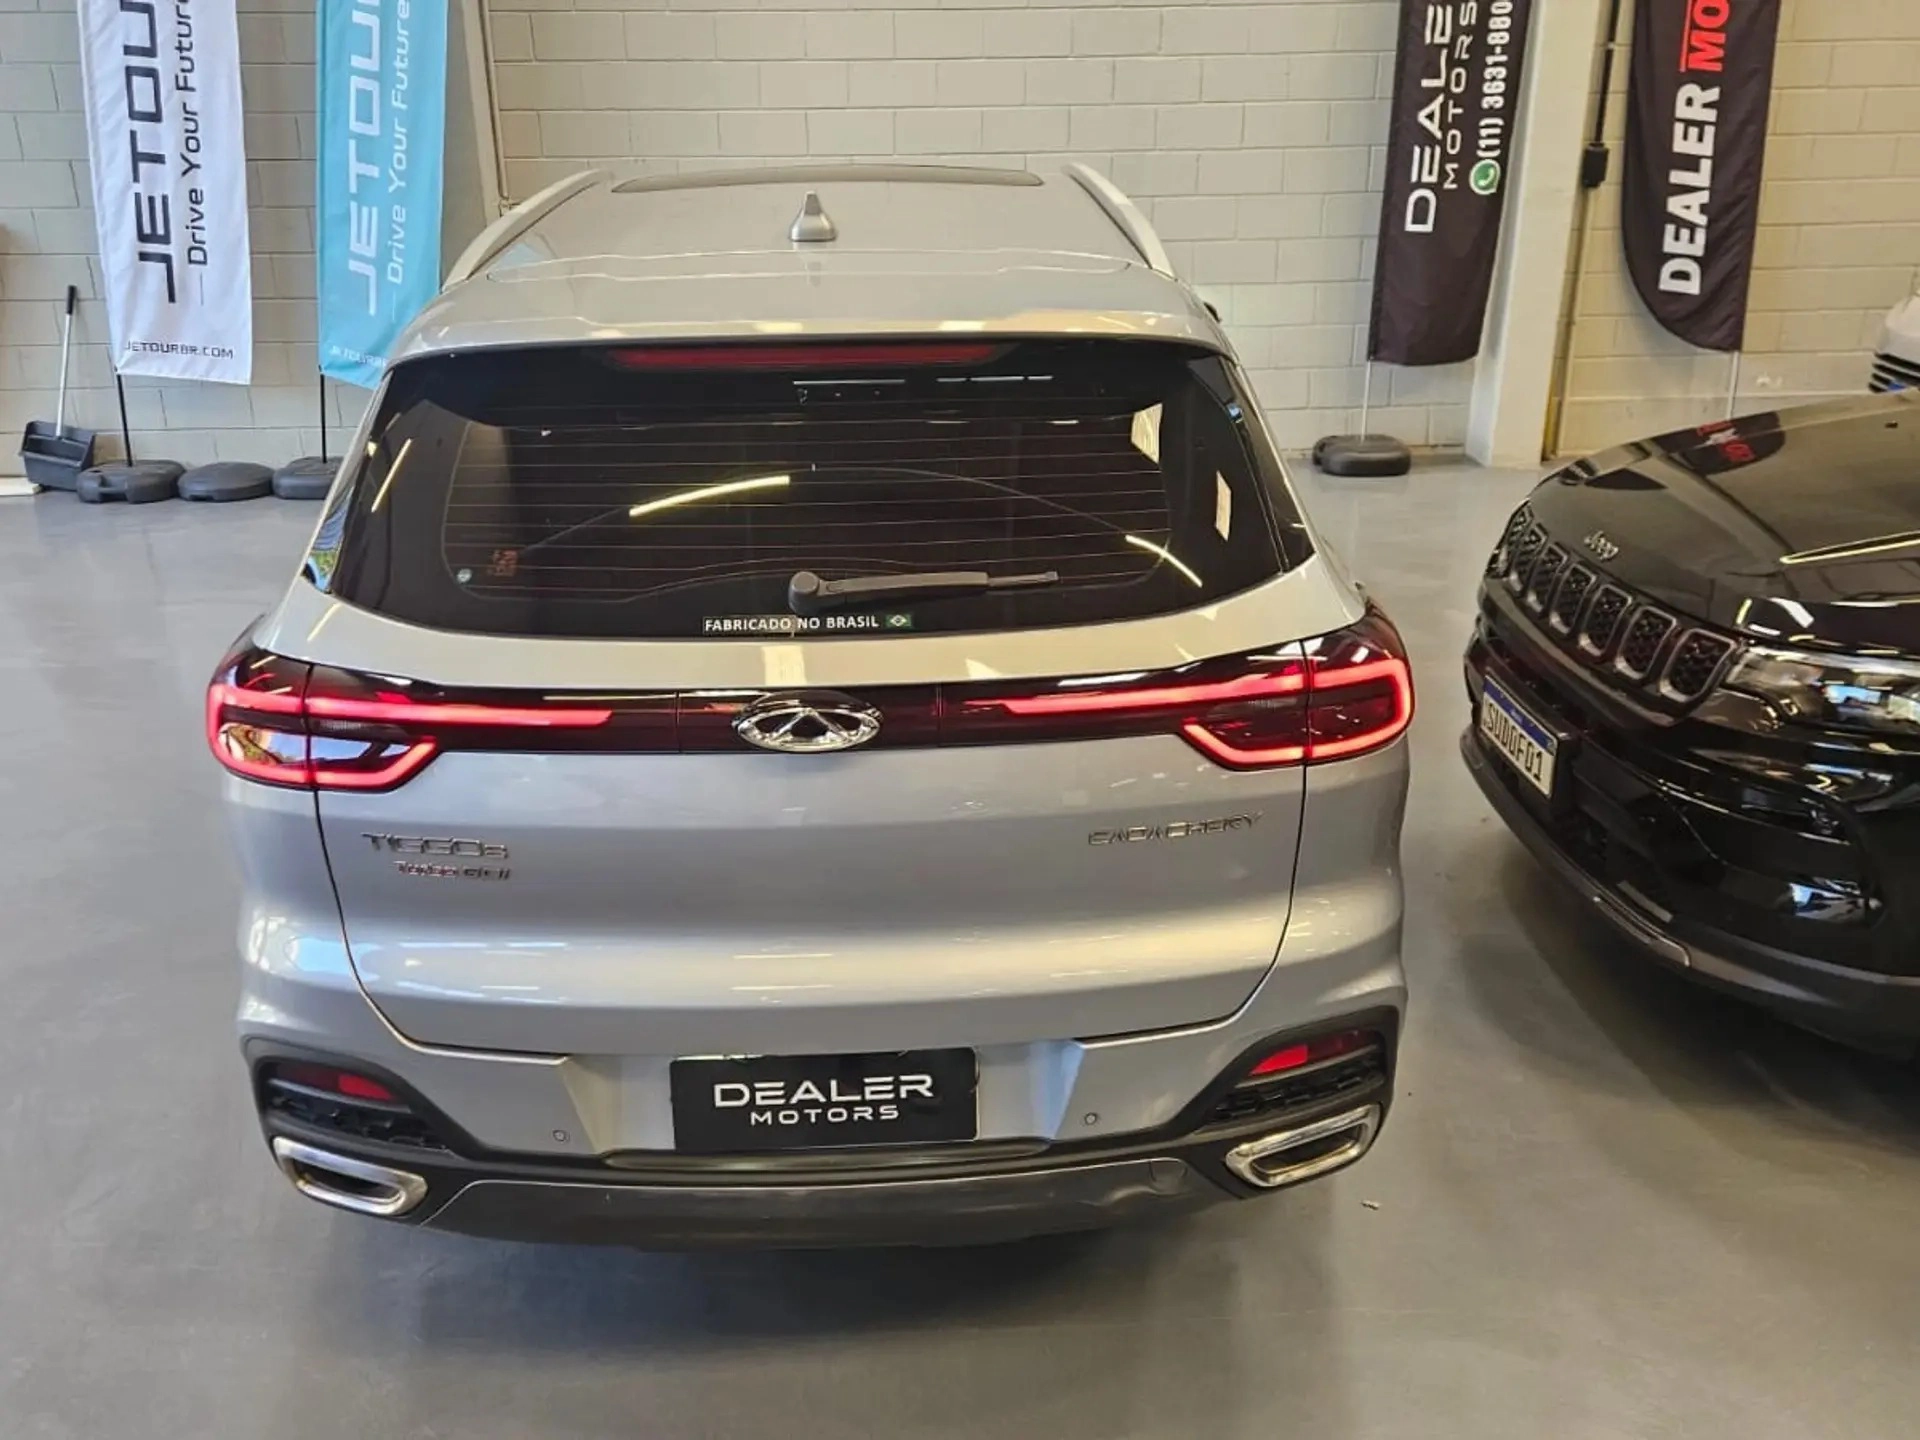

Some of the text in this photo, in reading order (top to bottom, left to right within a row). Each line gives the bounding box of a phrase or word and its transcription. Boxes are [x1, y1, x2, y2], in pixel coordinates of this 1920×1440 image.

[1443, 1, 1478, 190] MOTORS
[174, 0, 208, 266] Drive Your Futur
[388, 0, 410, 284] Drive Your Future
[1476, 117, 1504, 158] (11)
[1658, 82, 1721, 296] DEALER
[126, 340, 234, 359] JETOURBR.COM
[704, 615, 879, 632] FABRICADO NO BRASIL
[713, 1074, 935, 1108] DEALER
[749, 1104, 900, 1126] MOTORS
